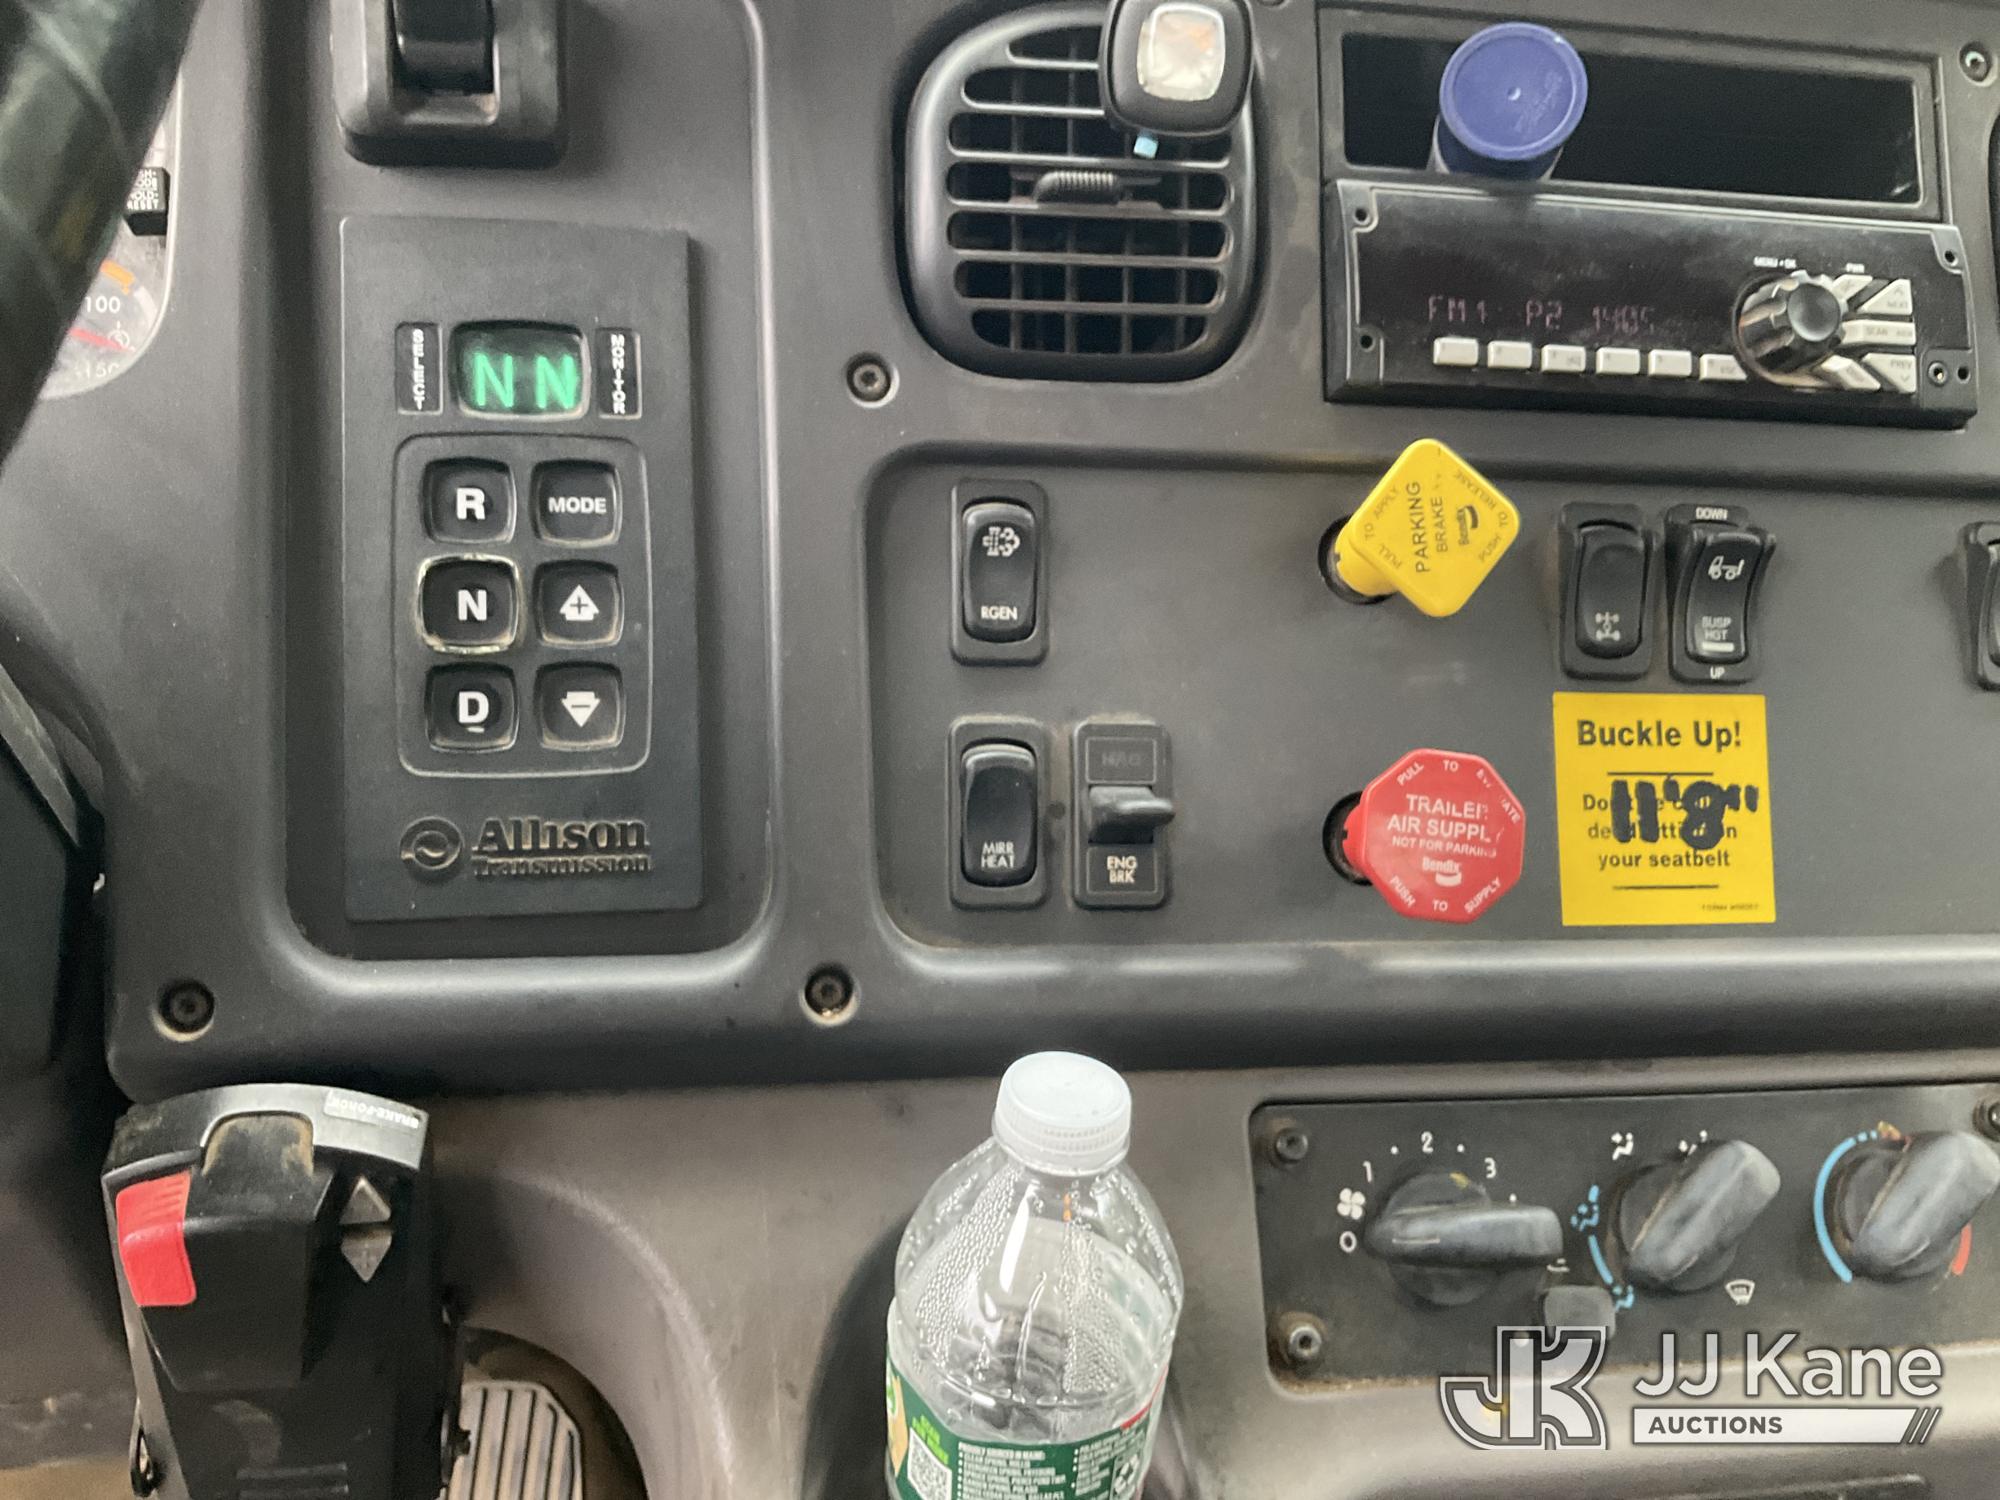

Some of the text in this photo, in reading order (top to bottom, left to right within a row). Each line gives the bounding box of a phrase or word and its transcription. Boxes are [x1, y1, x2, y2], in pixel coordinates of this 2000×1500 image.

[84, 296, 121, 313] 100
[1526, 300, 1563, 330] P2
[412, 328, 426, 411] SELECT
[610, 333, 626, 414] MONITOR
[456, 487, 486, 520] R
[548, 496, 608, 514] MODE
[1695, 507, 1728, 520] DOWN
[1364, 486, 1402, 569] PULL TO APPLY
[1406, 481, 1431, 573] PARKING
[1430, 496, 1449, 553] BRAKE
[1477, 534, 1502, 563] PUSH
[1498, 512, 1509, 528] TO
[458, 589, 488, 621] N
[981, 606, 1018, 621] RGEN
[1710, 667, 1725, 679] UP
[458, 691, 490, 724] D
[1577, 719, 1741, 753] Buckle Up!
[1396, 762, 1425, 787] PULL
[1443, 760, 1459, 772] TO
[471, 815, 650, 852] Allison
[1387, 814, 1501, 844] AIR SUPPL
[982, 841, 1014, 854] MIRR
[1392, 835, 1417, 848] NOT
[1419, 838, 1442, 851] FOR
[981, 855, 1015, 868] HEAT
[1106, 855, 1138, 870] ENG
[1598, 849, 1731, 872] your seatbelt
[1108, 869, 1135, 884] BRK
[1389, 875, 1502, 913] PUSH TO SUPPLY
[1420, 1131, 1434, 1153] 2
[1362, 1161, 1373, 1184] 1
[1484, 1157, 1497, 1179] 3
